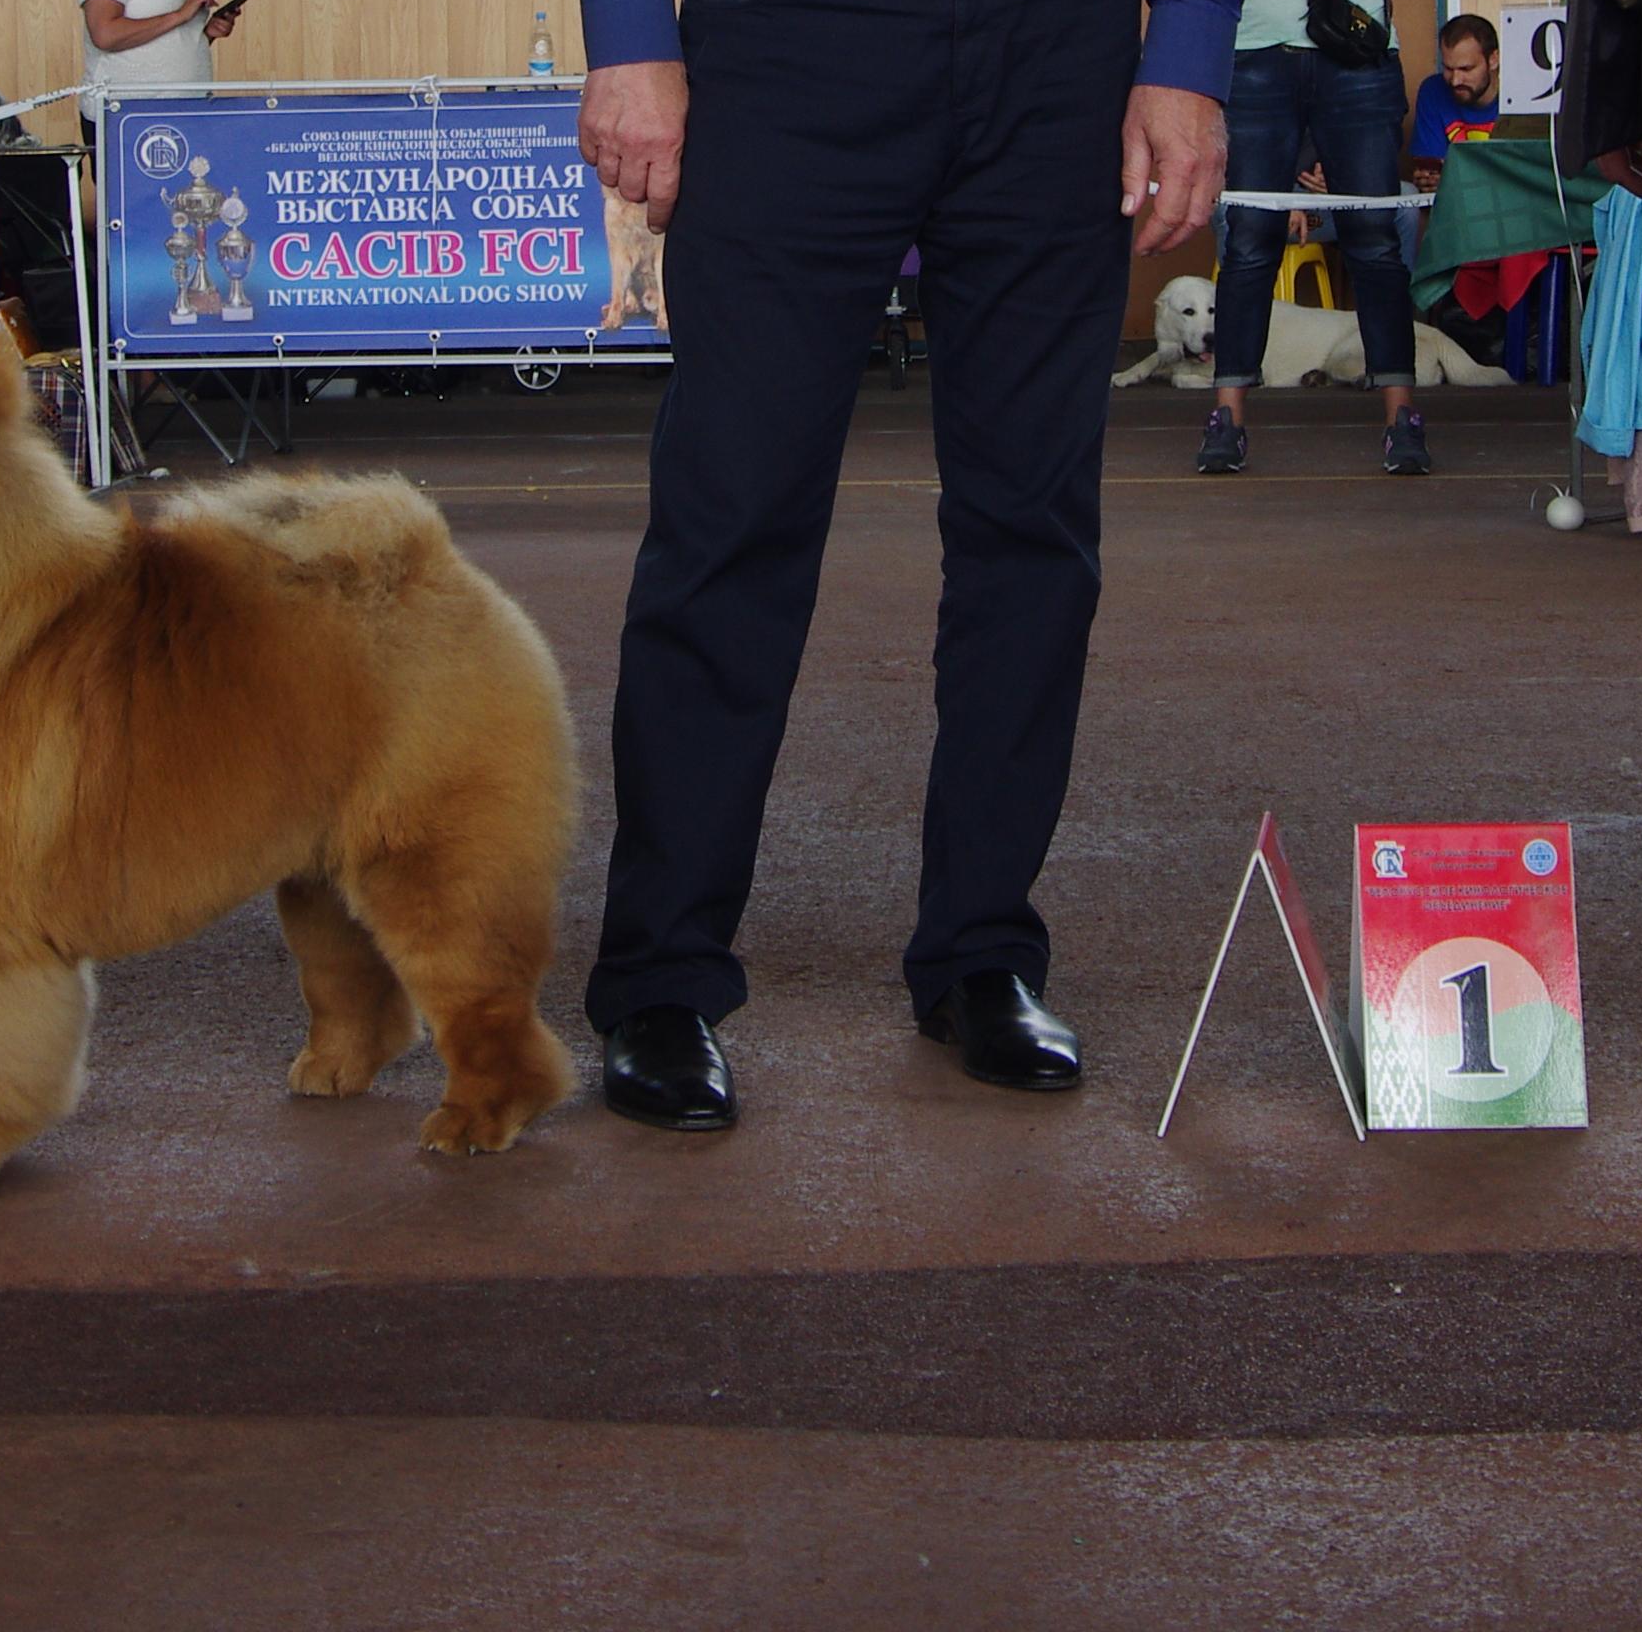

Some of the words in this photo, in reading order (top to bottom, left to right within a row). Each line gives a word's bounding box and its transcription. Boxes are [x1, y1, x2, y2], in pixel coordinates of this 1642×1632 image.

[302, 131, 339, 142] СОЮЗ
[450, 124, 547, 139] ОБЪЕДИНЕНИЙ
[318, 151, 403, 163] BELORUSSIAN
[404, 149, 490, 161] CINOLOGICAL
[491, 148, 532, 159] UNION
[266, 164, 585, 196] МЕЖДУНАРОДНАЯ
[277, 195, 456, 224] ВЫСТАВКА
[471, 193, 581, 220] СОБАК
[269, 230, 466, 280] CACIB
[479, 228, 585, 278] FCI
[268, 285, 455, 307] INTERNATIONAL
[459, 284, 512, 305] DOG
[514, 283, 589, 304] SHOW
[1439, 960, 1508, 1078] 1
